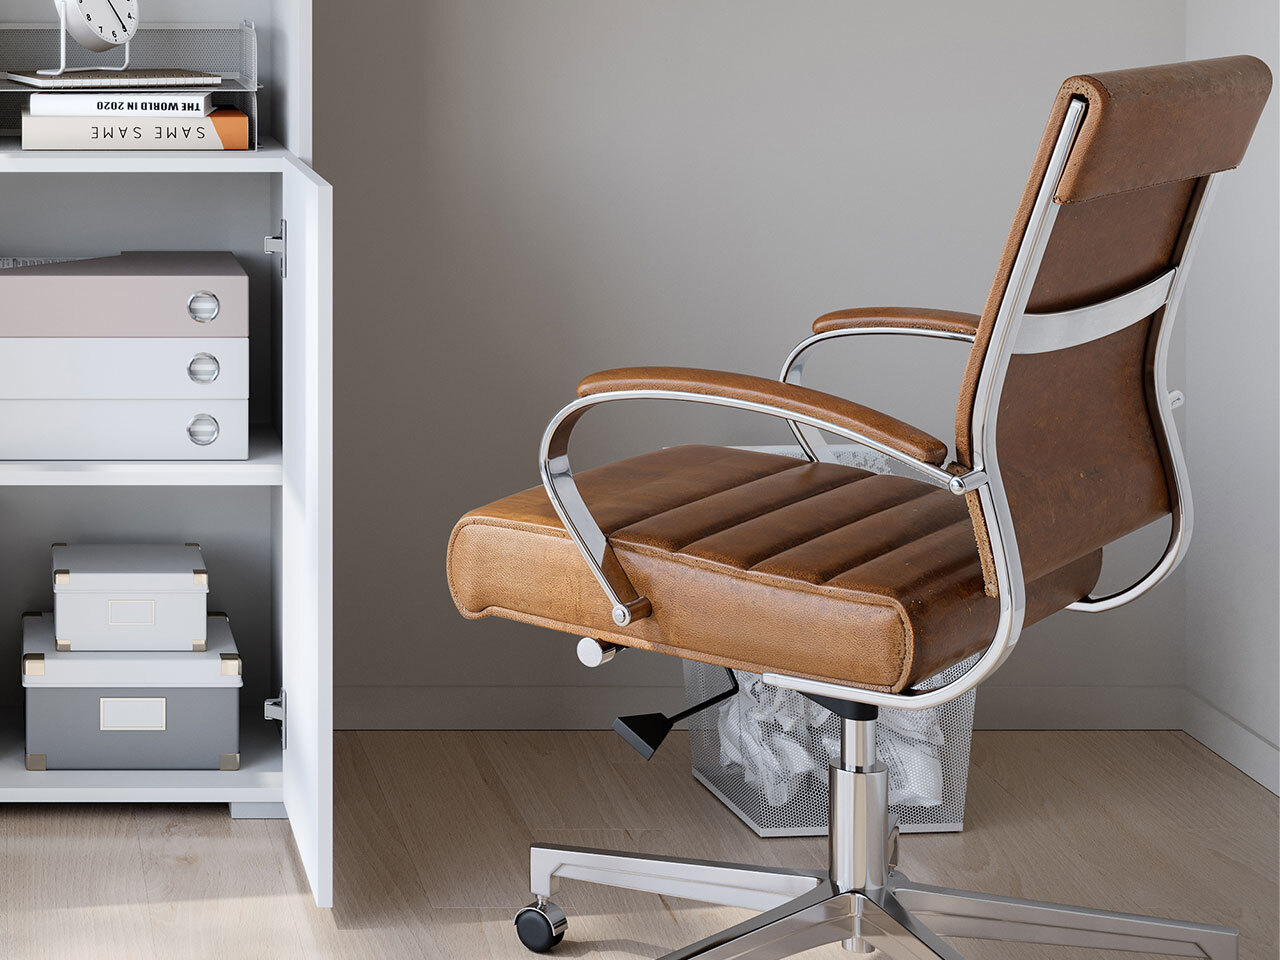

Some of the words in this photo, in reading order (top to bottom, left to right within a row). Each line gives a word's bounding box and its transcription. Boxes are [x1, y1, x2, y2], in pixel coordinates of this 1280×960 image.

[96, 101, 124, 110] 2020
[127, 101, 140, 111] IN
[141, 102, 179, 111] WORLD
[180, 102, 201, 112] THE
[91, 126, 142, 139] SAME
[154, 126, 206, 139] SAME
